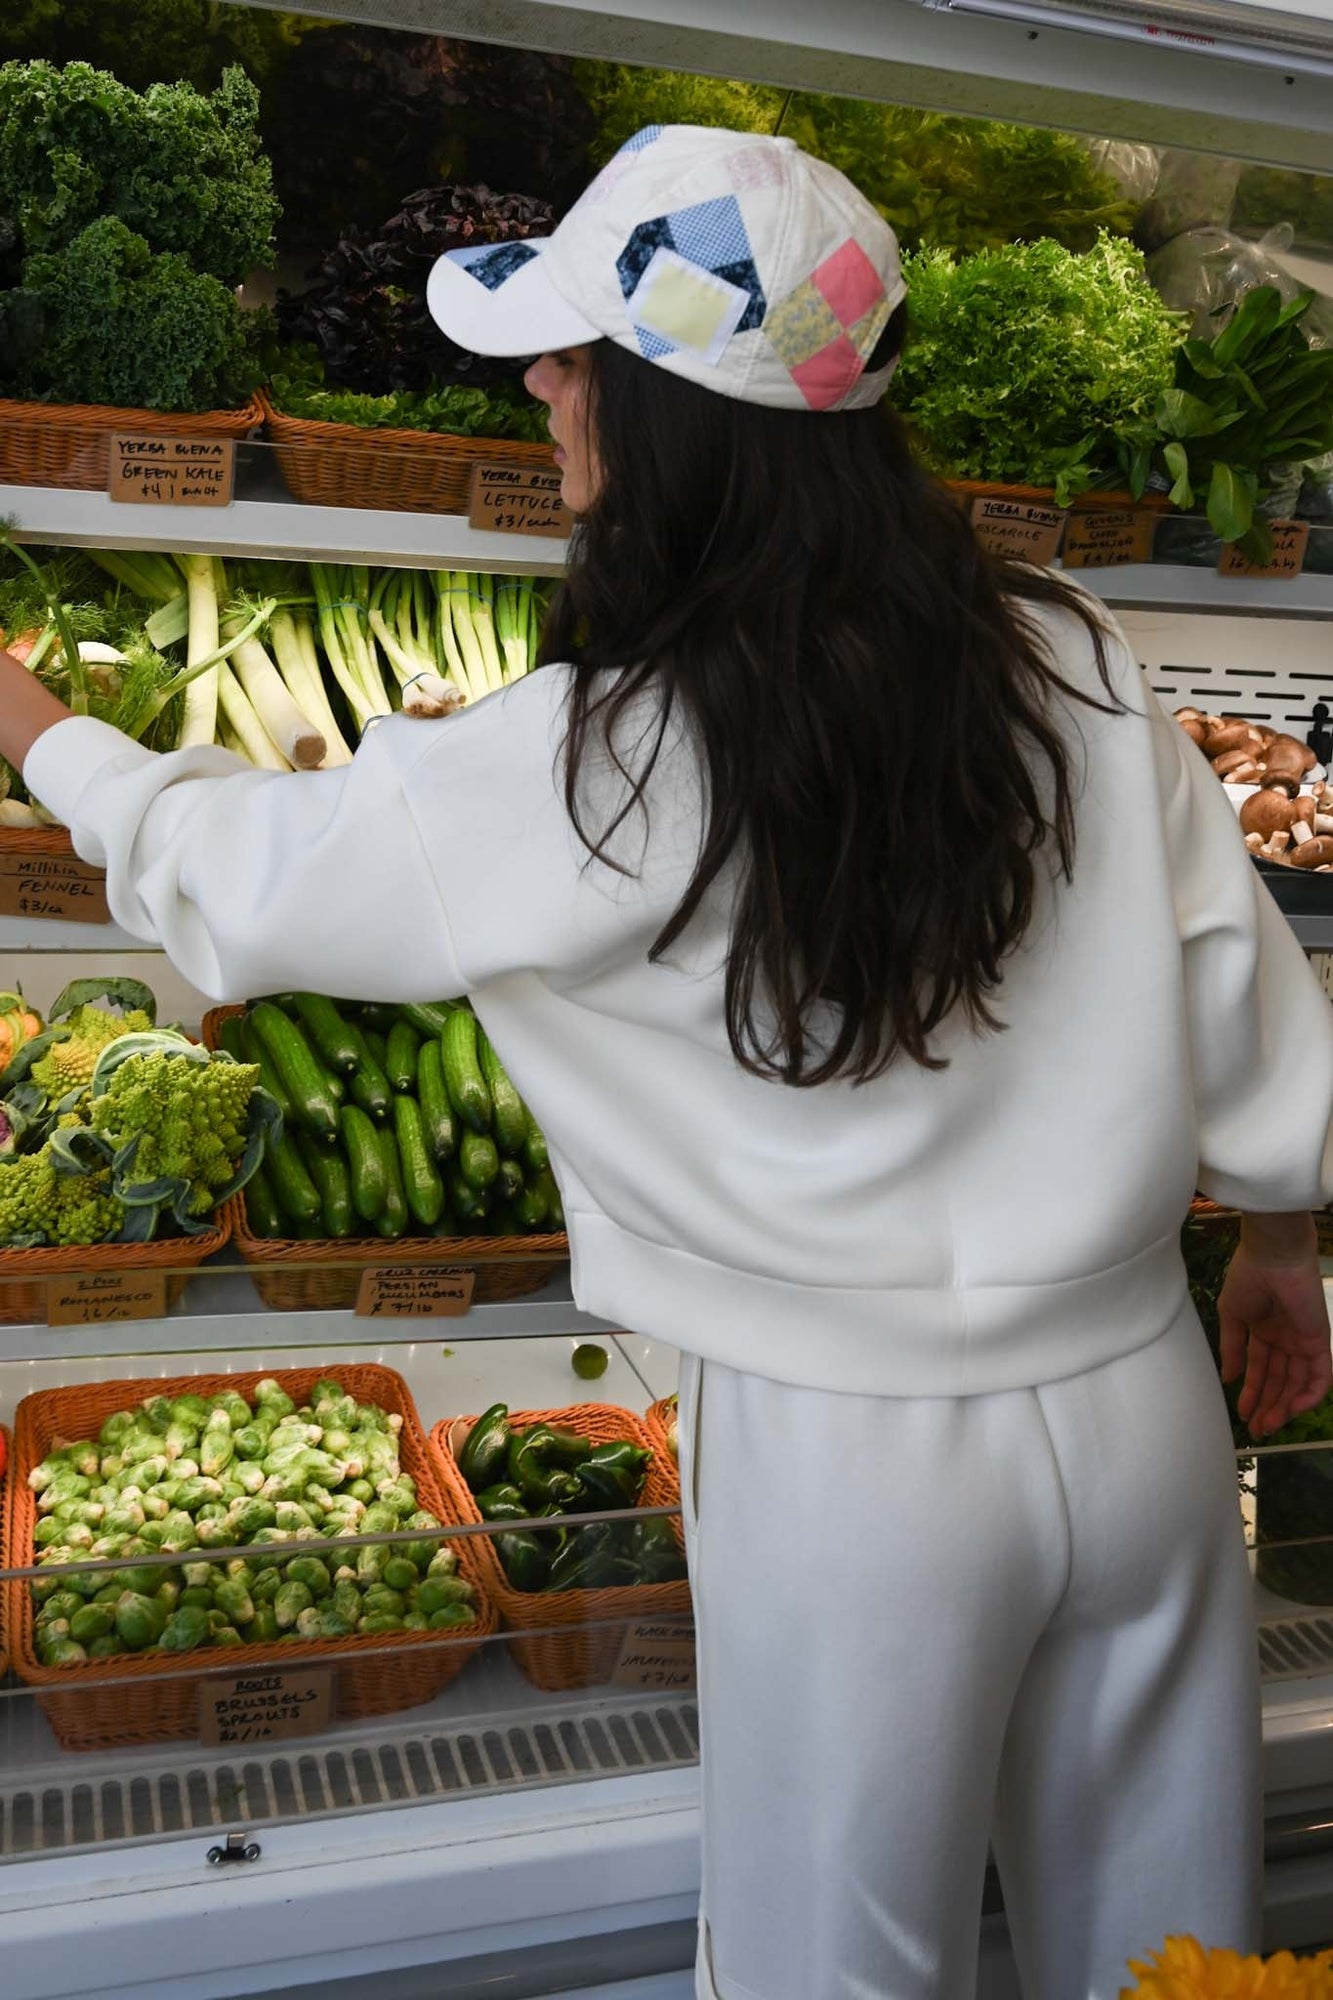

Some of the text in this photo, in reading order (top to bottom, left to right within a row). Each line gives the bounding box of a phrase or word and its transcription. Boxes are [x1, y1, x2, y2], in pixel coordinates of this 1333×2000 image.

[118, 441, 223, 455] YERBA BUENA
[122, 462, 224, 481] GREEN KALE
[482, 469, 521, 483] YERBA
[484, 492, 563, 510] LETTUCE
[984, 502, 1020, 515] YERBA
[976, 524, 1042, 541] ESCAROLE
[18, 880, 94, 896] FENNEL
[19, 897, 64, 914] $3/ea
[377, 1281, 438, 1292] PERSIAN
[214, 1689, 318, 1714] BRUSSELS
[217, 1705, 300, 1728] SPROUTS
